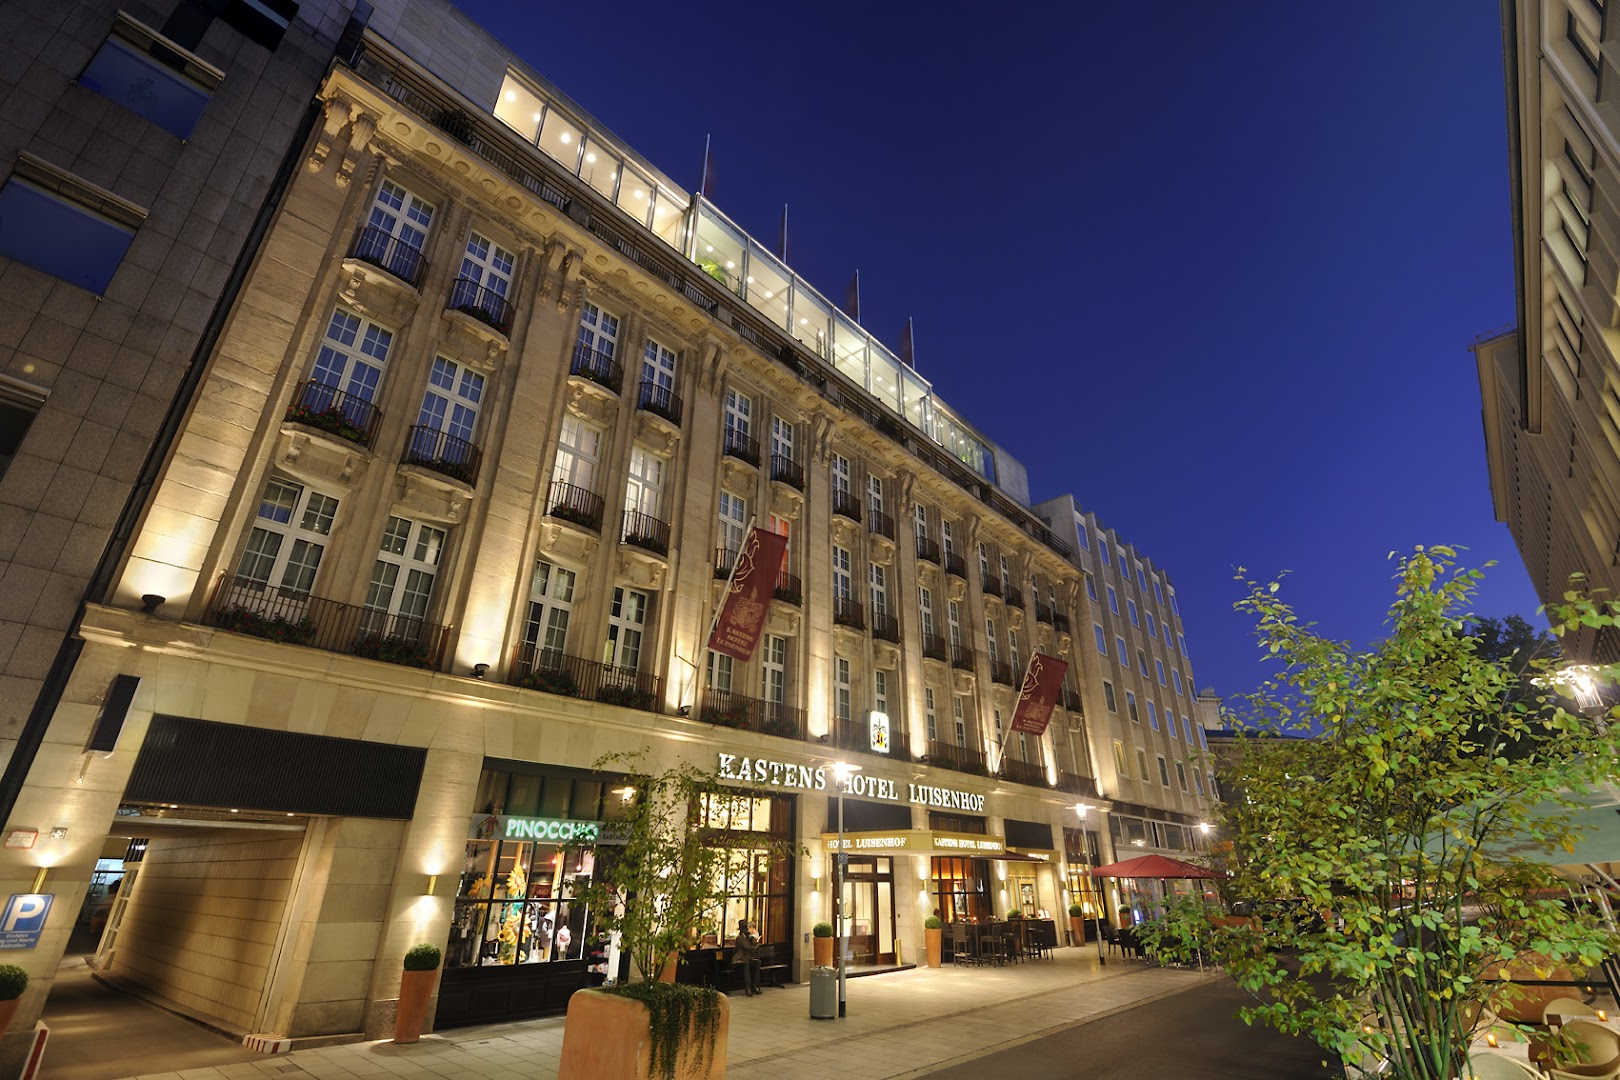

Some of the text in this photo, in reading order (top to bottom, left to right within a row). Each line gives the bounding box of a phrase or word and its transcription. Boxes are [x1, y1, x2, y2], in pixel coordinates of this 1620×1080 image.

[726, 634, 748, 647] HOTEL
[718, 752, 985, 812] KASTENS HOTEL LUISENHOF
[827, 837, 907, 849] HOEL LUISENHOF
[3, 896, 46, 930] P
